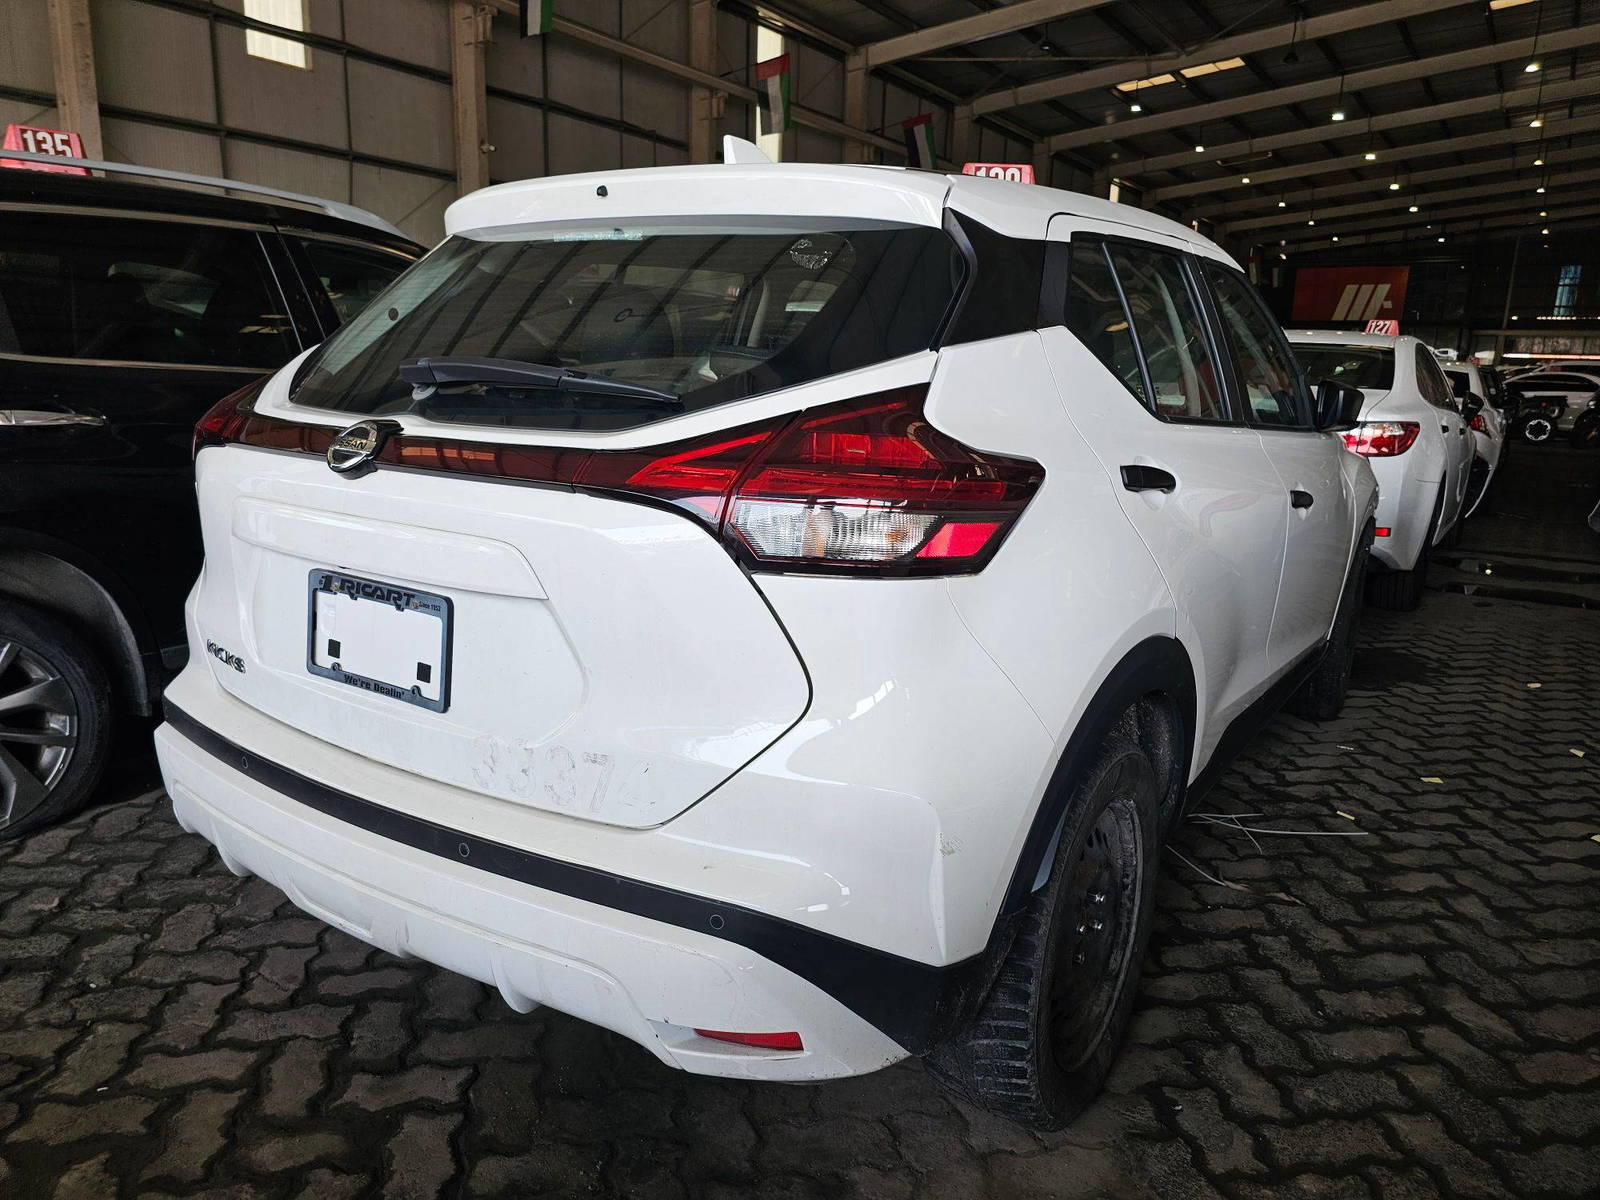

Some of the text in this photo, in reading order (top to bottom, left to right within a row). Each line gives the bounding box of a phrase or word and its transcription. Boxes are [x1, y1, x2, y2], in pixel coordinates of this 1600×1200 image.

[23, 130, 74, 158] 135
[1370, 320, 1391, 335] 127
[340, 578, 416, 612] RICART
[343, 674, 405, 699] We're Dealin'
